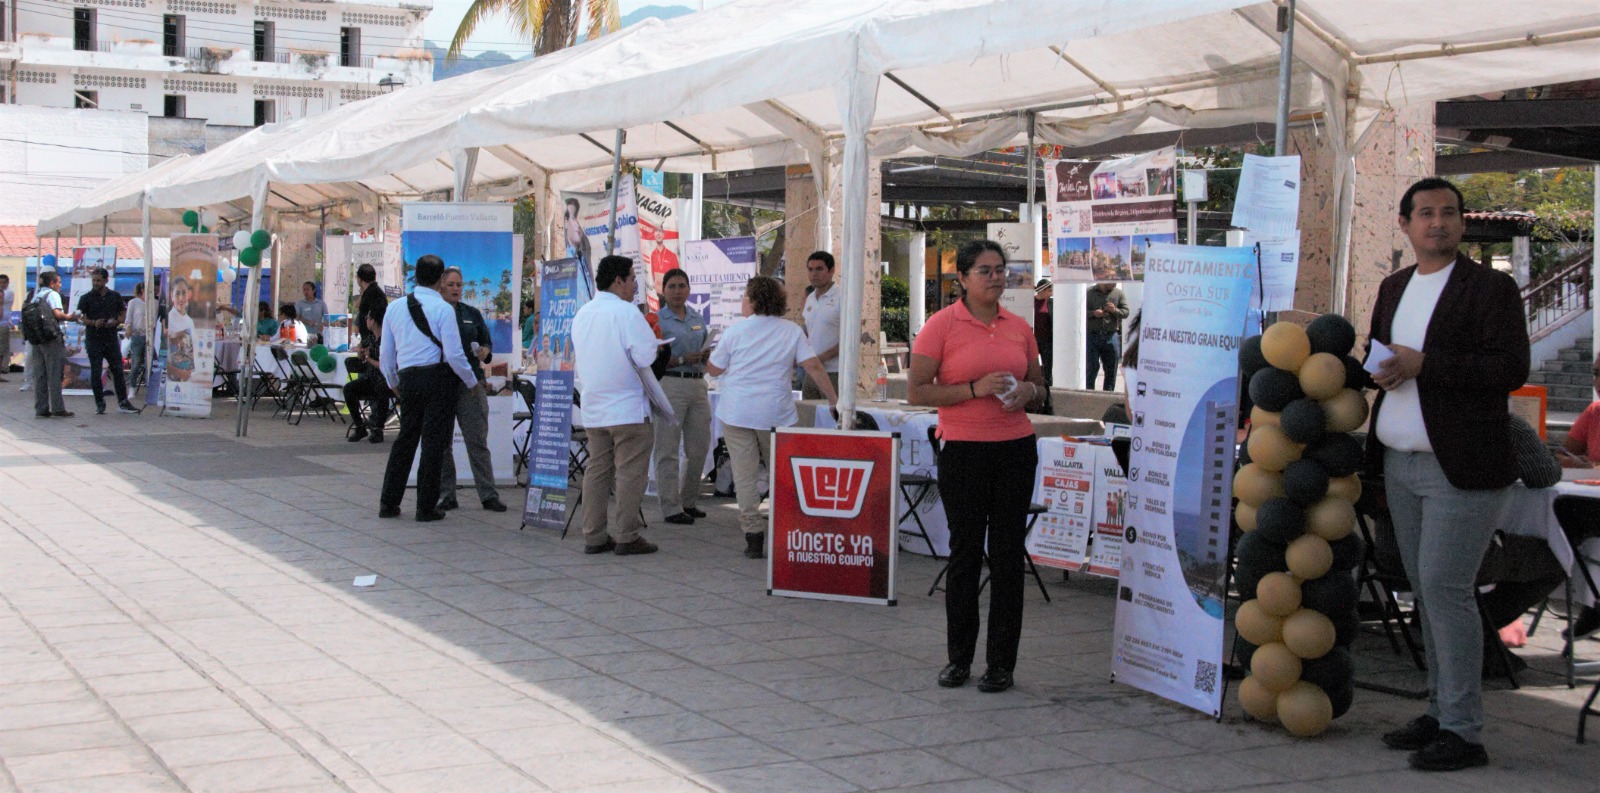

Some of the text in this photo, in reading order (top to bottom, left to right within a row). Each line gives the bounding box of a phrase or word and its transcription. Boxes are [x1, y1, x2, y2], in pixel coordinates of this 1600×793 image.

[417, 212, 498, 222] Barceló Puerto Vallarta
[1148, 258, 1254, 279] RECLUTAMIENTO
[690, 273, 751, 282] RECLUTAMIENTO
[1166, 282, 1230, 300] COSTA SUR
[548, 299, 576, 318] PUERTO
[1162, 329, 1168, 341] A
[1168, 330, 1197, 346] NUESTRO
[1198, 333, 1218, 348] GRAN
[1152, 388, 1181, 398] TRANSPORTE
[1154, 420, 1176, 429] COMEDOR
[1145, 446, 1177, 458] PUNTUALIDAD
[1054, 460, 1084, 470] VALLARTA
[1148, 470, 1162, 479] BONO
[1054, 478, 1079, 490] CAJAS
[1144, 477, 1170, 488] ASISTENCIA
[1146, 498, 1166, 508] VALES DE
[1144, 504, 1166, 515] DESPENSA
[1142, 530, 1166, 542] BONO POR
[788, 528, 873, 556] ¡ÚNETE YA
[1137, 536, 1172, 551] CONTRATACIÓN
[788, 552, 794, 562] A
[796, 552, 836, 565] NUESTRO
[1142, 562, 1165, 573] ATENCIÓN
